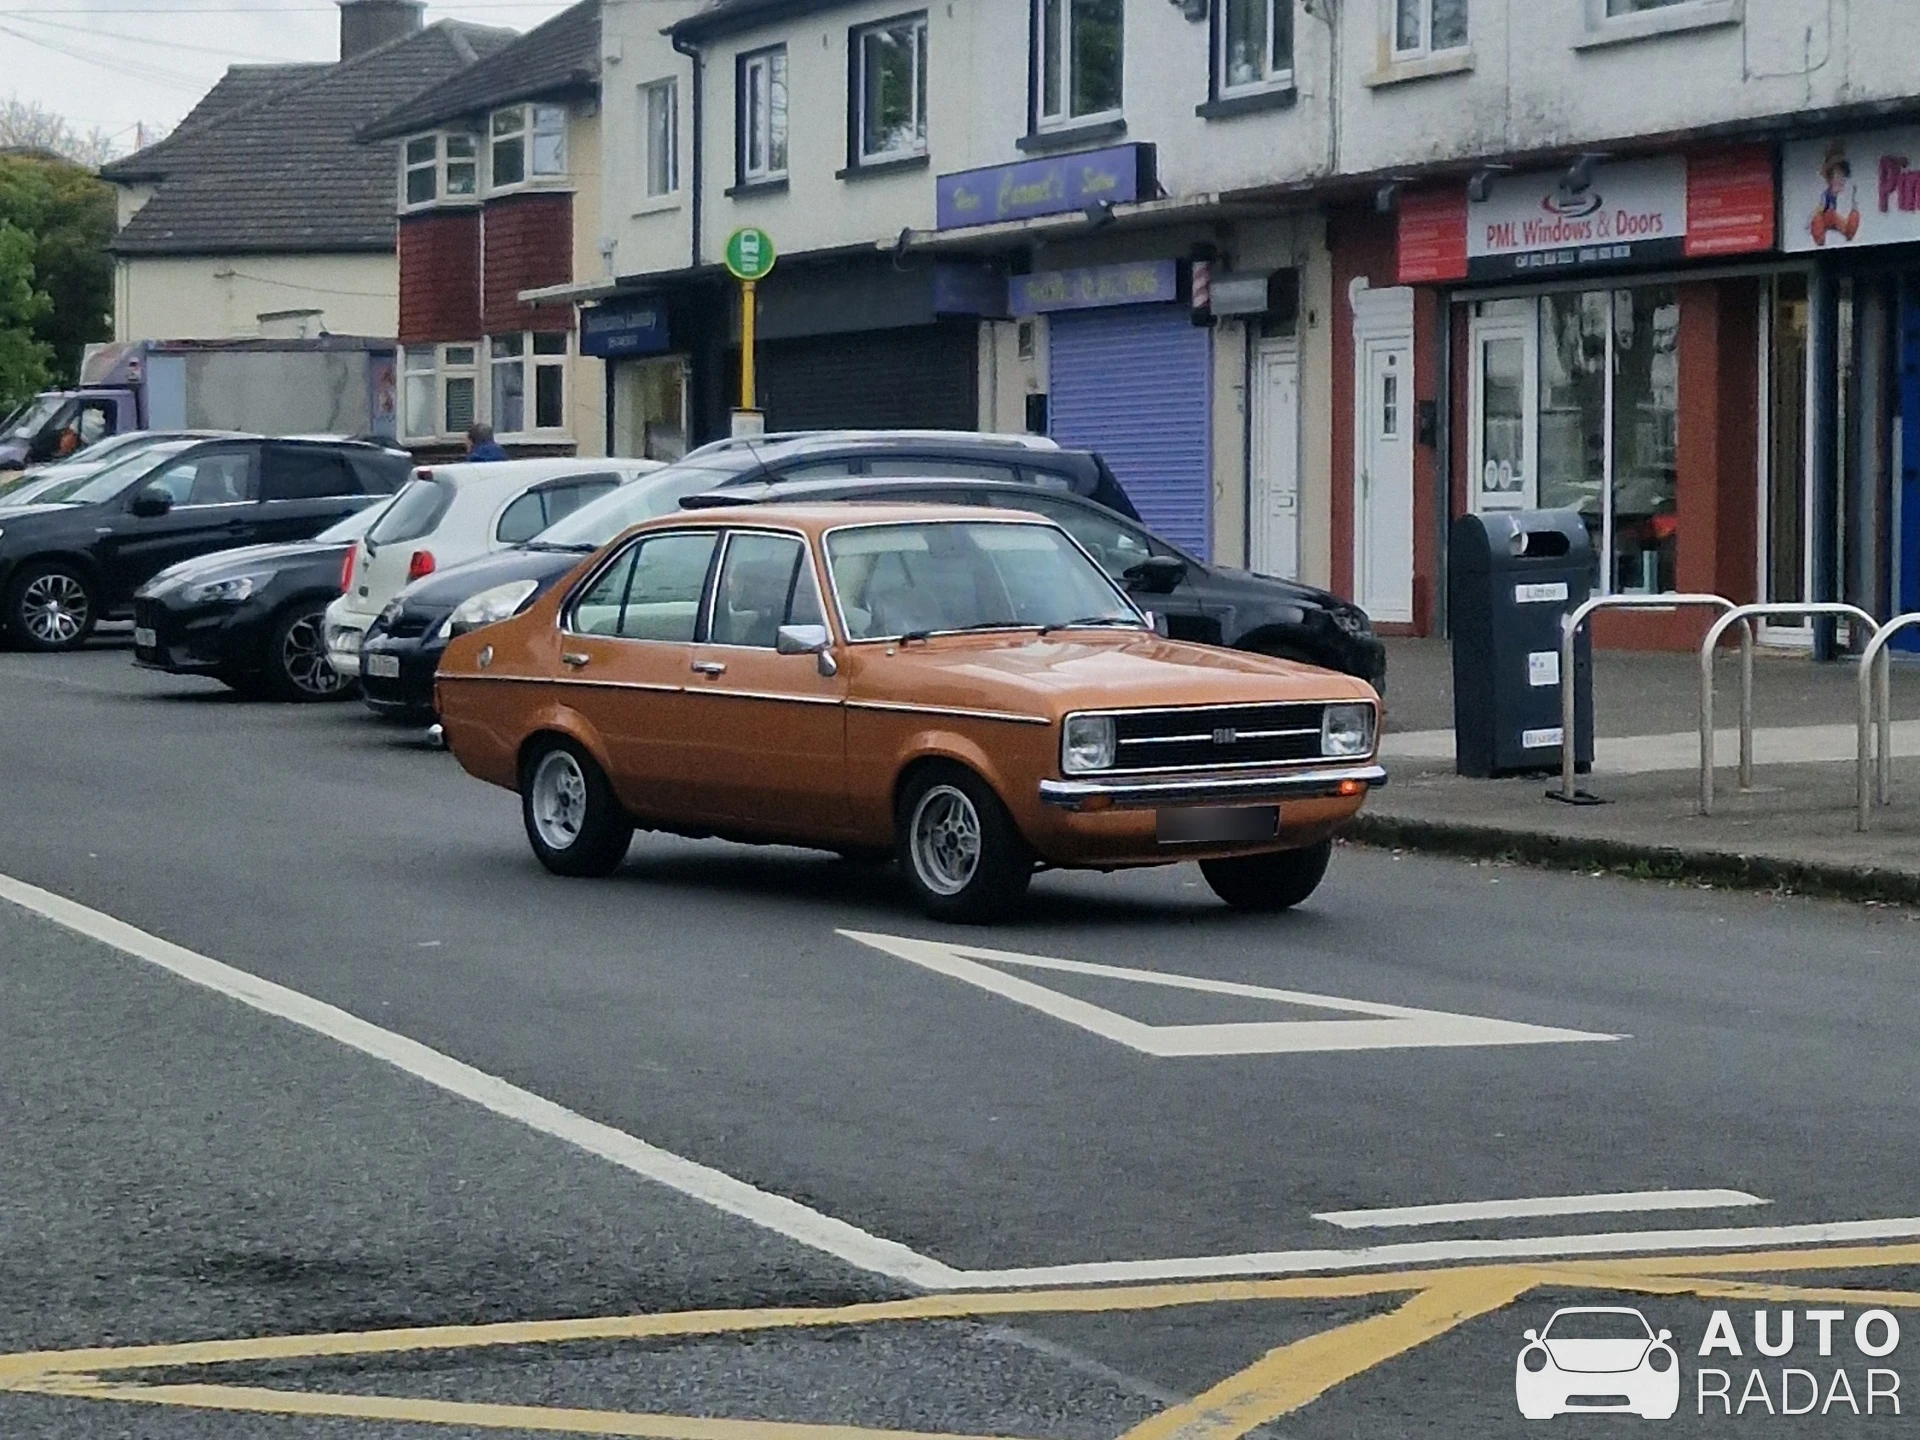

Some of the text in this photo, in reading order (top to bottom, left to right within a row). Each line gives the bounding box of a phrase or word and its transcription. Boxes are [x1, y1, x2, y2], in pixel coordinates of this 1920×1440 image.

[1487, 209, 1663, 248] PML Windows & Doors
[1526, 586, 1556, 599] Litter
